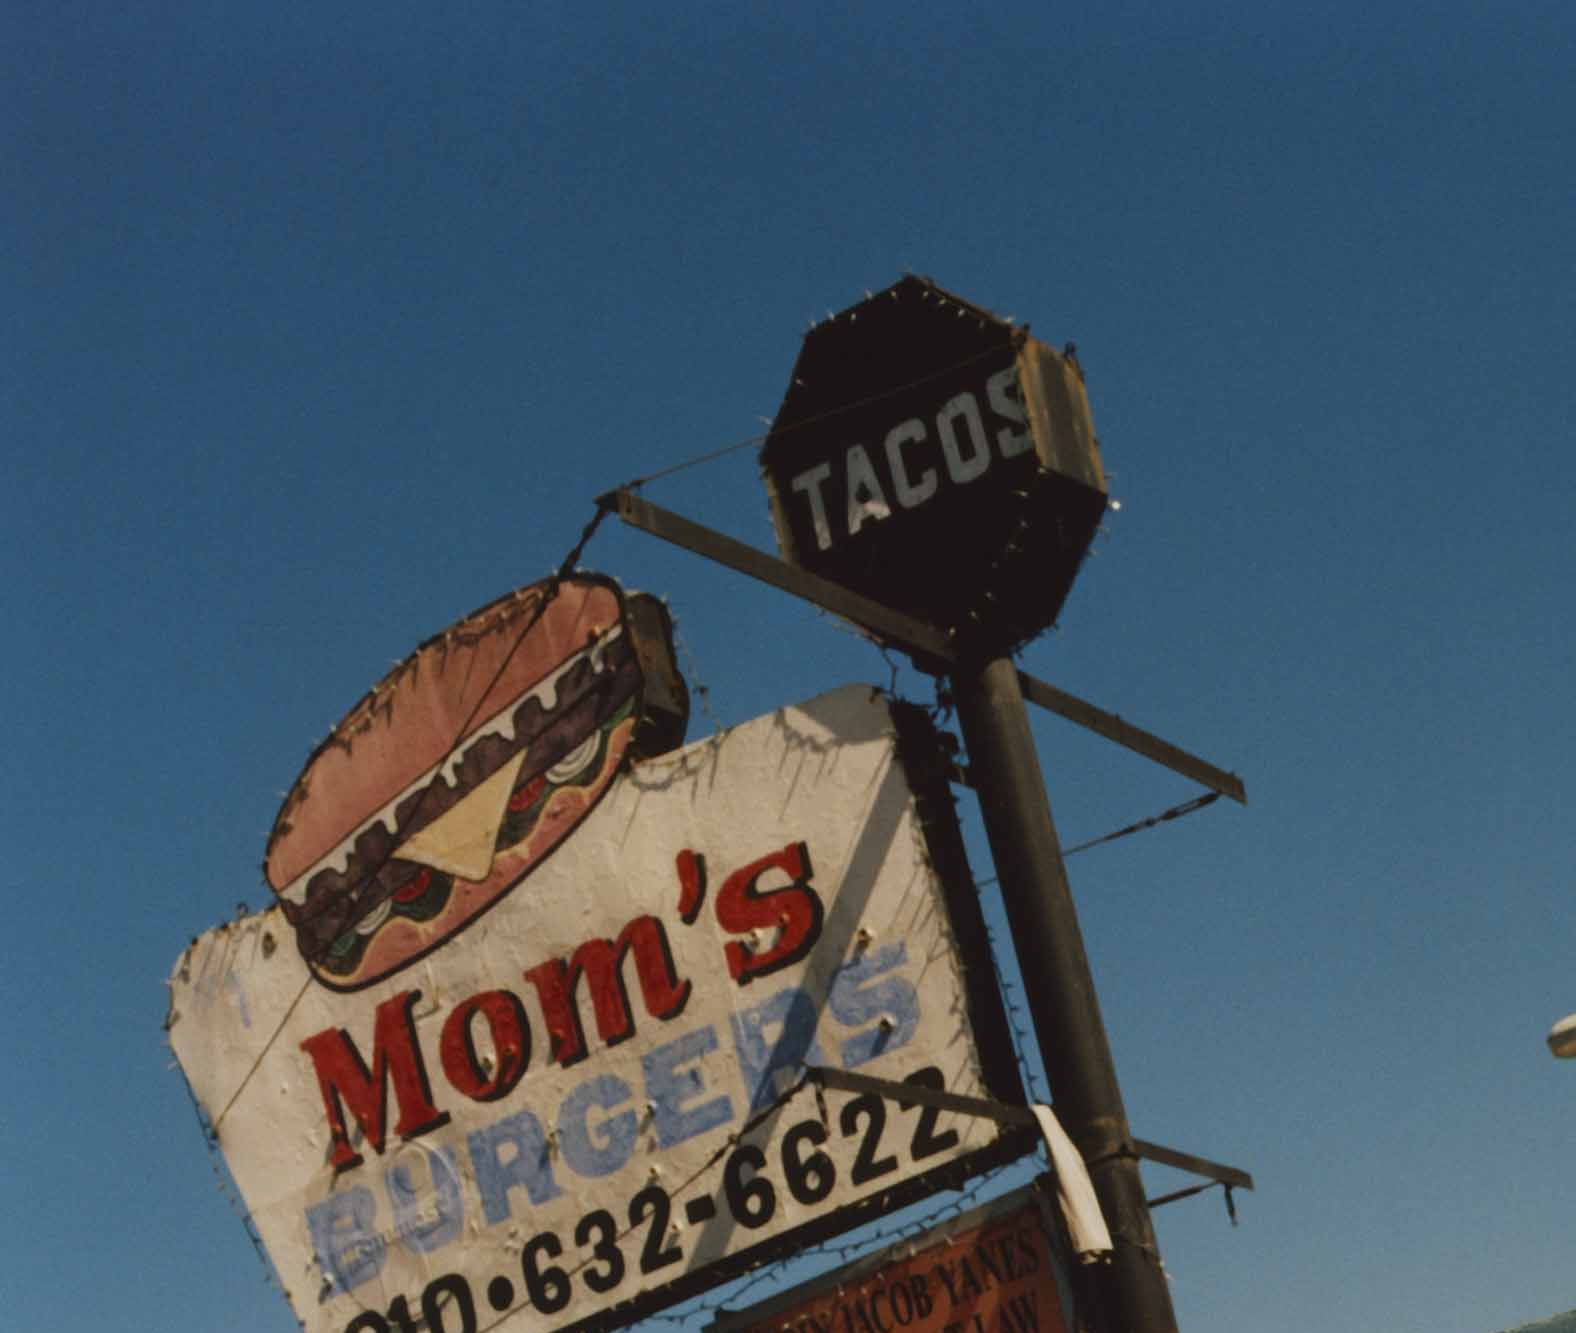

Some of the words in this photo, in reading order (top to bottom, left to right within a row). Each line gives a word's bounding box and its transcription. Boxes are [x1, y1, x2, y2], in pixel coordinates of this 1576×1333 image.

[791, 364, 1034, 551] TACOS
[299, 841, 824, 1172] Mom's
[304, 941, 921, 1296] BURGERS
[934, 1229, 1041, 1304] YANES
